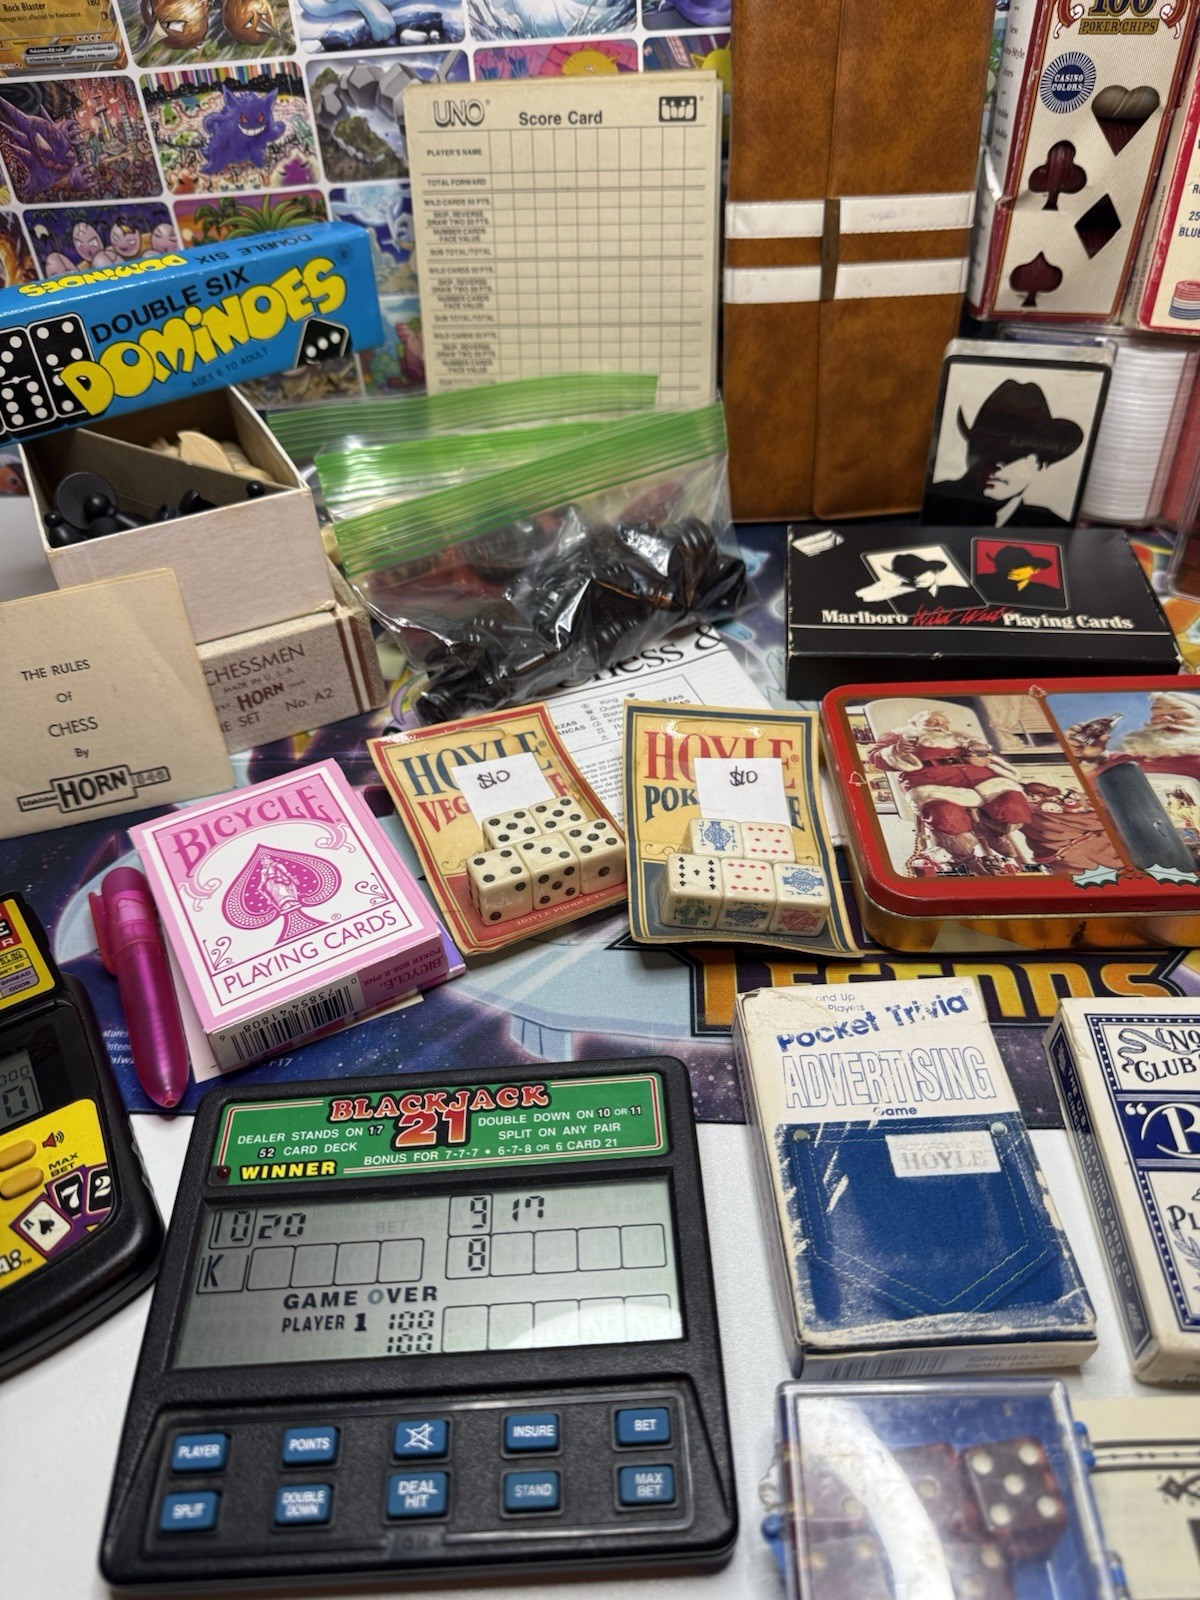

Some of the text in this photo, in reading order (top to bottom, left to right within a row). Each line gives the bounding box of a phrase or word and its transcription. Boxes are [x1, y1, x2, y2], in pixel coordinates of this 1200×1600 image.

[3, 2, 46, 12] Rock Blaster
[1081, 21, 1157, 32] POKER CHIPS
[1051, 83, 1084, 92] COLORS
[1054, 74, 1085, 83] CASINO
[433, 99, 603, 127] UNO Score Card
[426, 149, 461, 157] PLAYER'S
[427, 178, 487, 187] TOTAL FORWARD
[241, 234, 312, 257] DOUBLE
[194, 251, 230, 264] SIX
[90, 266, 251, 344] DOUBLE SIX
[191, 375, 216, 389] AGES
[225, 363, 240, 375] TO
[240, 346, 269, 367] ADULT
[821, 609, 909, 625] Marlboro
[1002, 612, 1076, 630] Playing
[1077, 614, 1135, 630] Cards
[21, 659, 91, 682] THE RULES
[223, 681, 249, 694] MADE
[236, 682, 285, 712] HORN
[238, 711, 261, 728] SET
[315, 687, 336, 703] A2
[48, 716, 99, 738] CHESS
[75, 746, 90, 759] By
[476, 769, 511, 790] $10
[729, 765, 759, 788] $10
[56, 770, 128, 809] HORN
[172, 785, 342, 878] BICYCLE
[223, 909, 397, 994] PLAYING CARDS
[411, 946, 442, 967] POKER
[292, 987, 336, 1013] 73854
[840, 992, 857, 1005] Up
[242, 1008, 288, 1034] 41808
[776, 993, 971, 1054] Pocket Trivia
[781, 1046, 999, 1109] ADVERTISING
[1134, 1056, 1198, 1084] CLUB
[330, 1085, 550, 1122] BLACKJACK
[477, 1105, 643, 1127] DOUBLE DOWN ON 10 OR 11
[238, 1124, 385, 1145] DEALER STANDS ON 17
[395, 1109, 467, 1148] 21
[498, 1122, 622, 1141] SPLIT ON ANY PAIR
[257, 1142, 358, 1159] 52 CARD DECK
[363, 1137, 619, 1167] BONUS FOR 7-7-7 6-7-8 OR 6 CARD 21
[899, 1149, 990, 1171] HOYLE
[48, 1152, 80, 1171] MAX
[50, 1162, 77, 1177] BET
[240, 1160, 337, 1181] WINNER
[60, 1174, 112, 1210] 7 2
[469, 1195, 546, 1229] 9 17
[257, 1211, 307, 1241] 20
[467, 1237, 487, 1272] 8
[203, 1253, 225, 1288] K
[283, 1285, 439, 1310] GAME OVER
[281, 1309, 435, 1333] PLAYER 1 100
[386, 1332, 434, 1354] 100
[512, 1424, 556, 1438] INSURE
[633, 1418, 658, 1431] BET
[177, 1444, 221, 1460] PLAYER
[288, 1436, 331, 1452] POINTS
[397, 1479, 438, 1495] DEAL
[634, 1472, 664, 1486] MAX
[280, 1490, 326, 1505] DOUBLE
[513, 1483, 553, 1498] STAND
[636, 1484, 663, 1498] BET
[171, 1502, 207, 1520] SPLIT
[284, 1503, 321, 1519] DOWN
[403, 1494, 430, 1509] HIT
